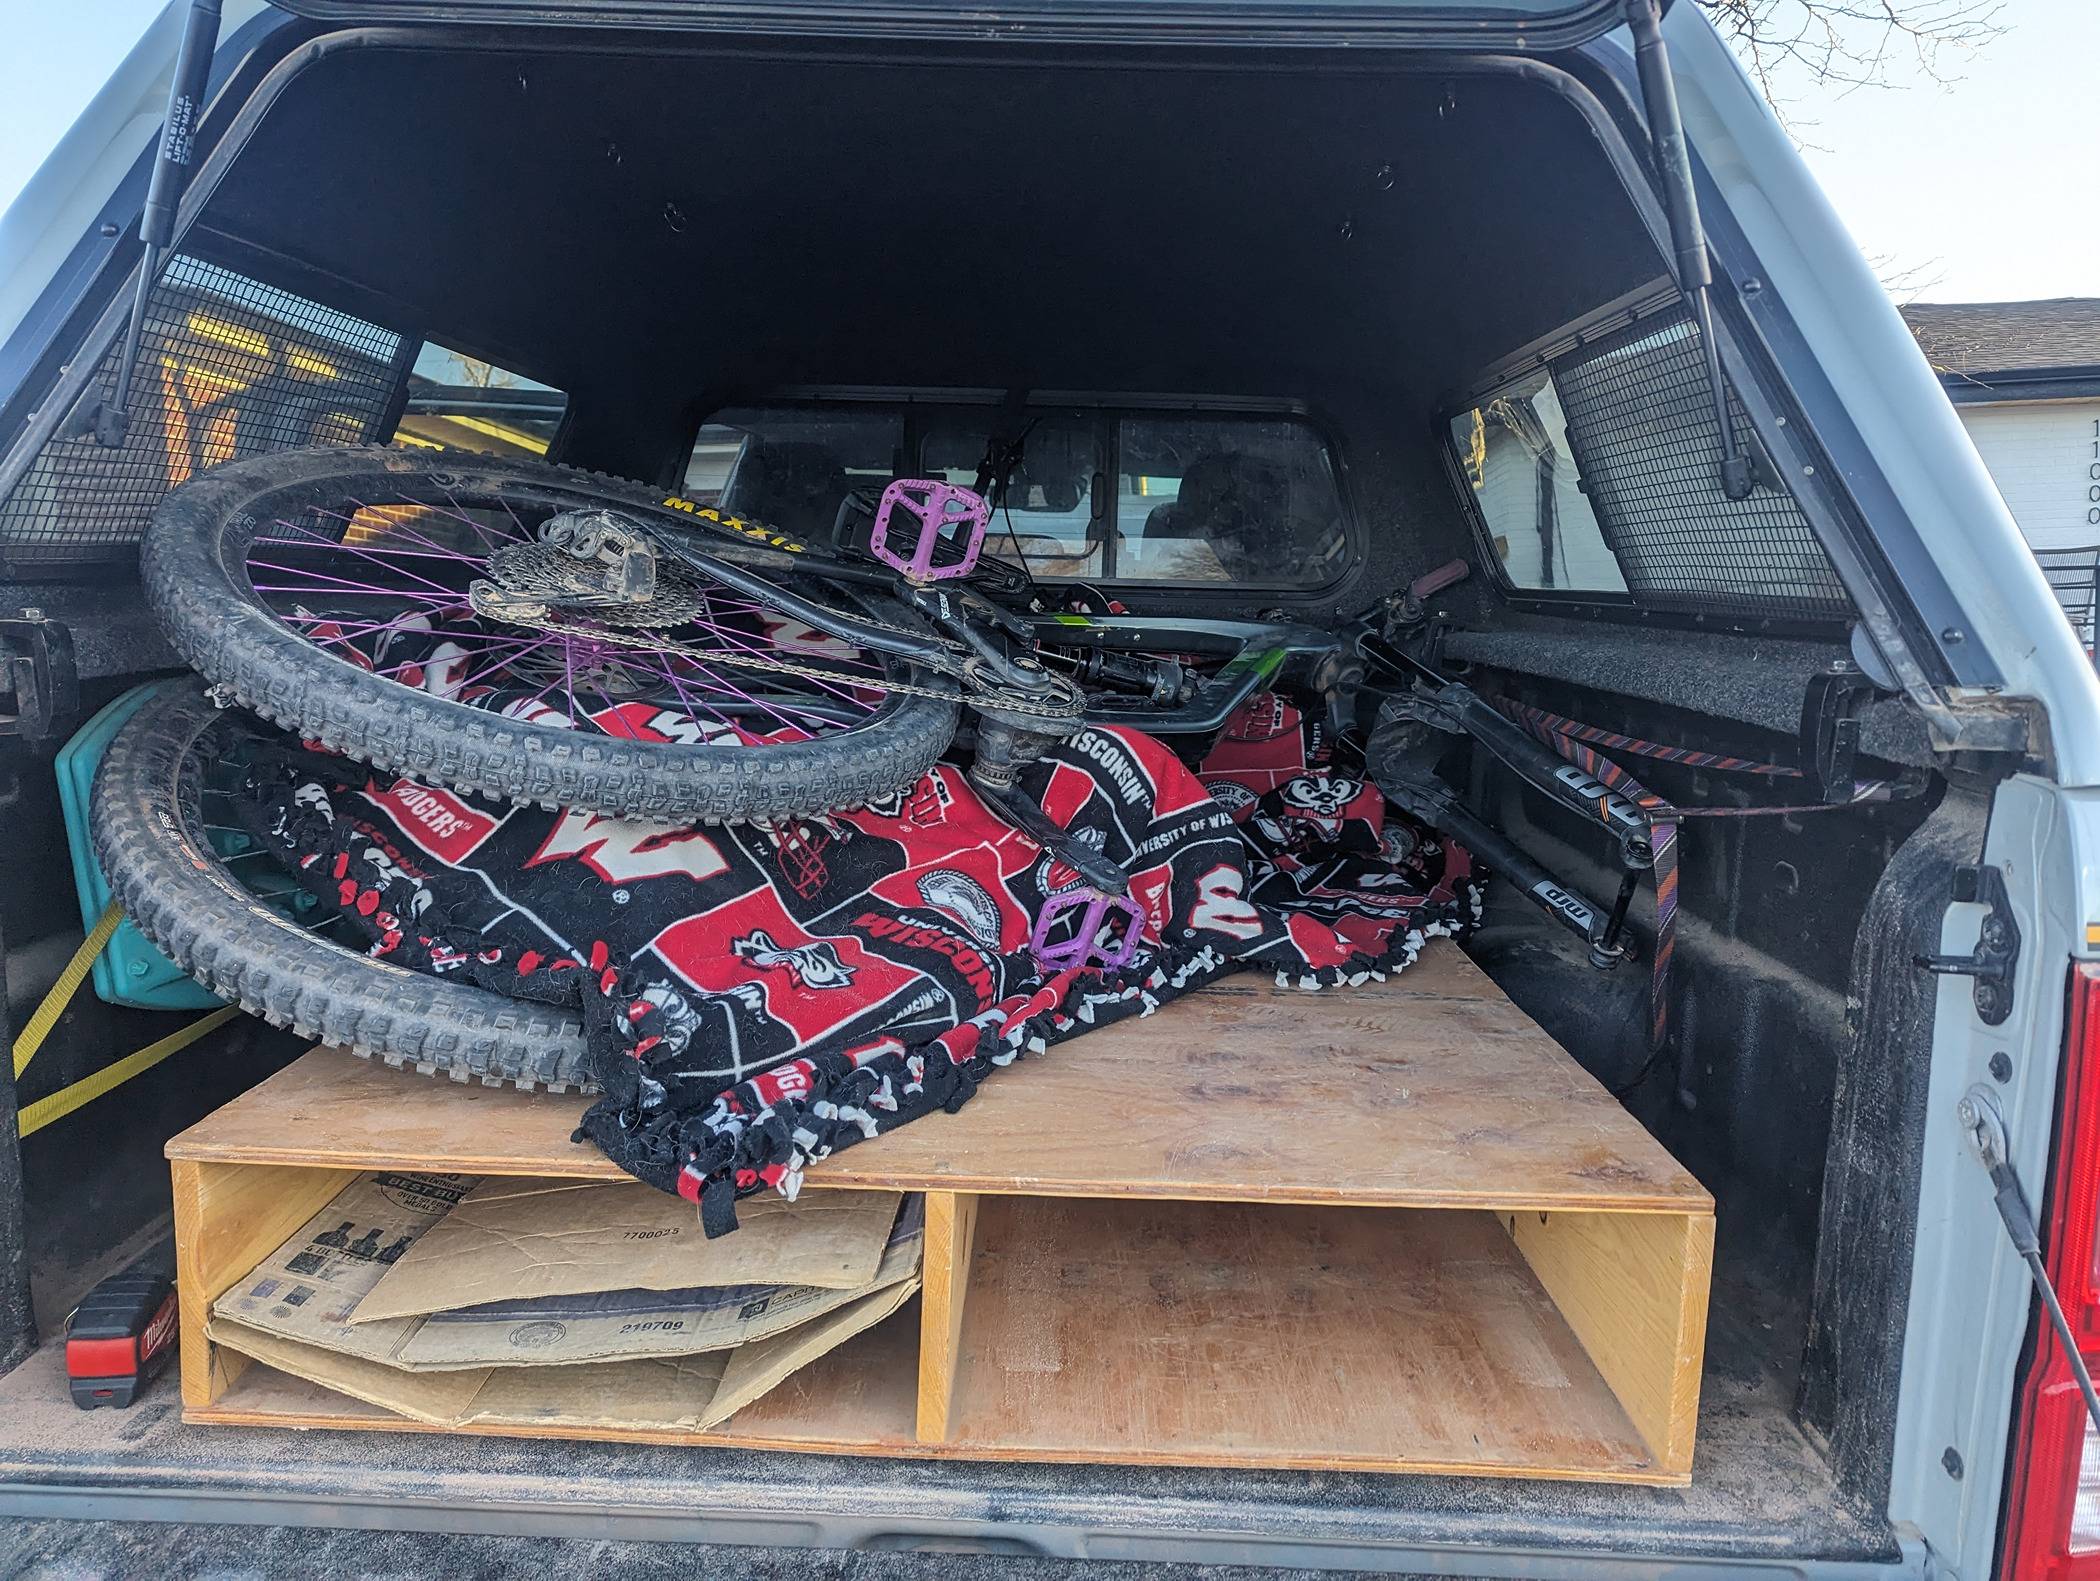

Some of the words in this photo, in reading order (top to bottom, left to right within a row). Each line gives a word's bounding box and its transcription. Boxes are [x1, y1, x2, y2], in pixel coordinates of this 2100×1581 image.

[164, 96, 184, 160] STABILUS
[662, 496, 807, 553] MAXXIS
[1191, 818, 1206, 832] OF
[623, 1227, 680, 1240] 7700025
[620, 1320, 684, 1334] 219709
